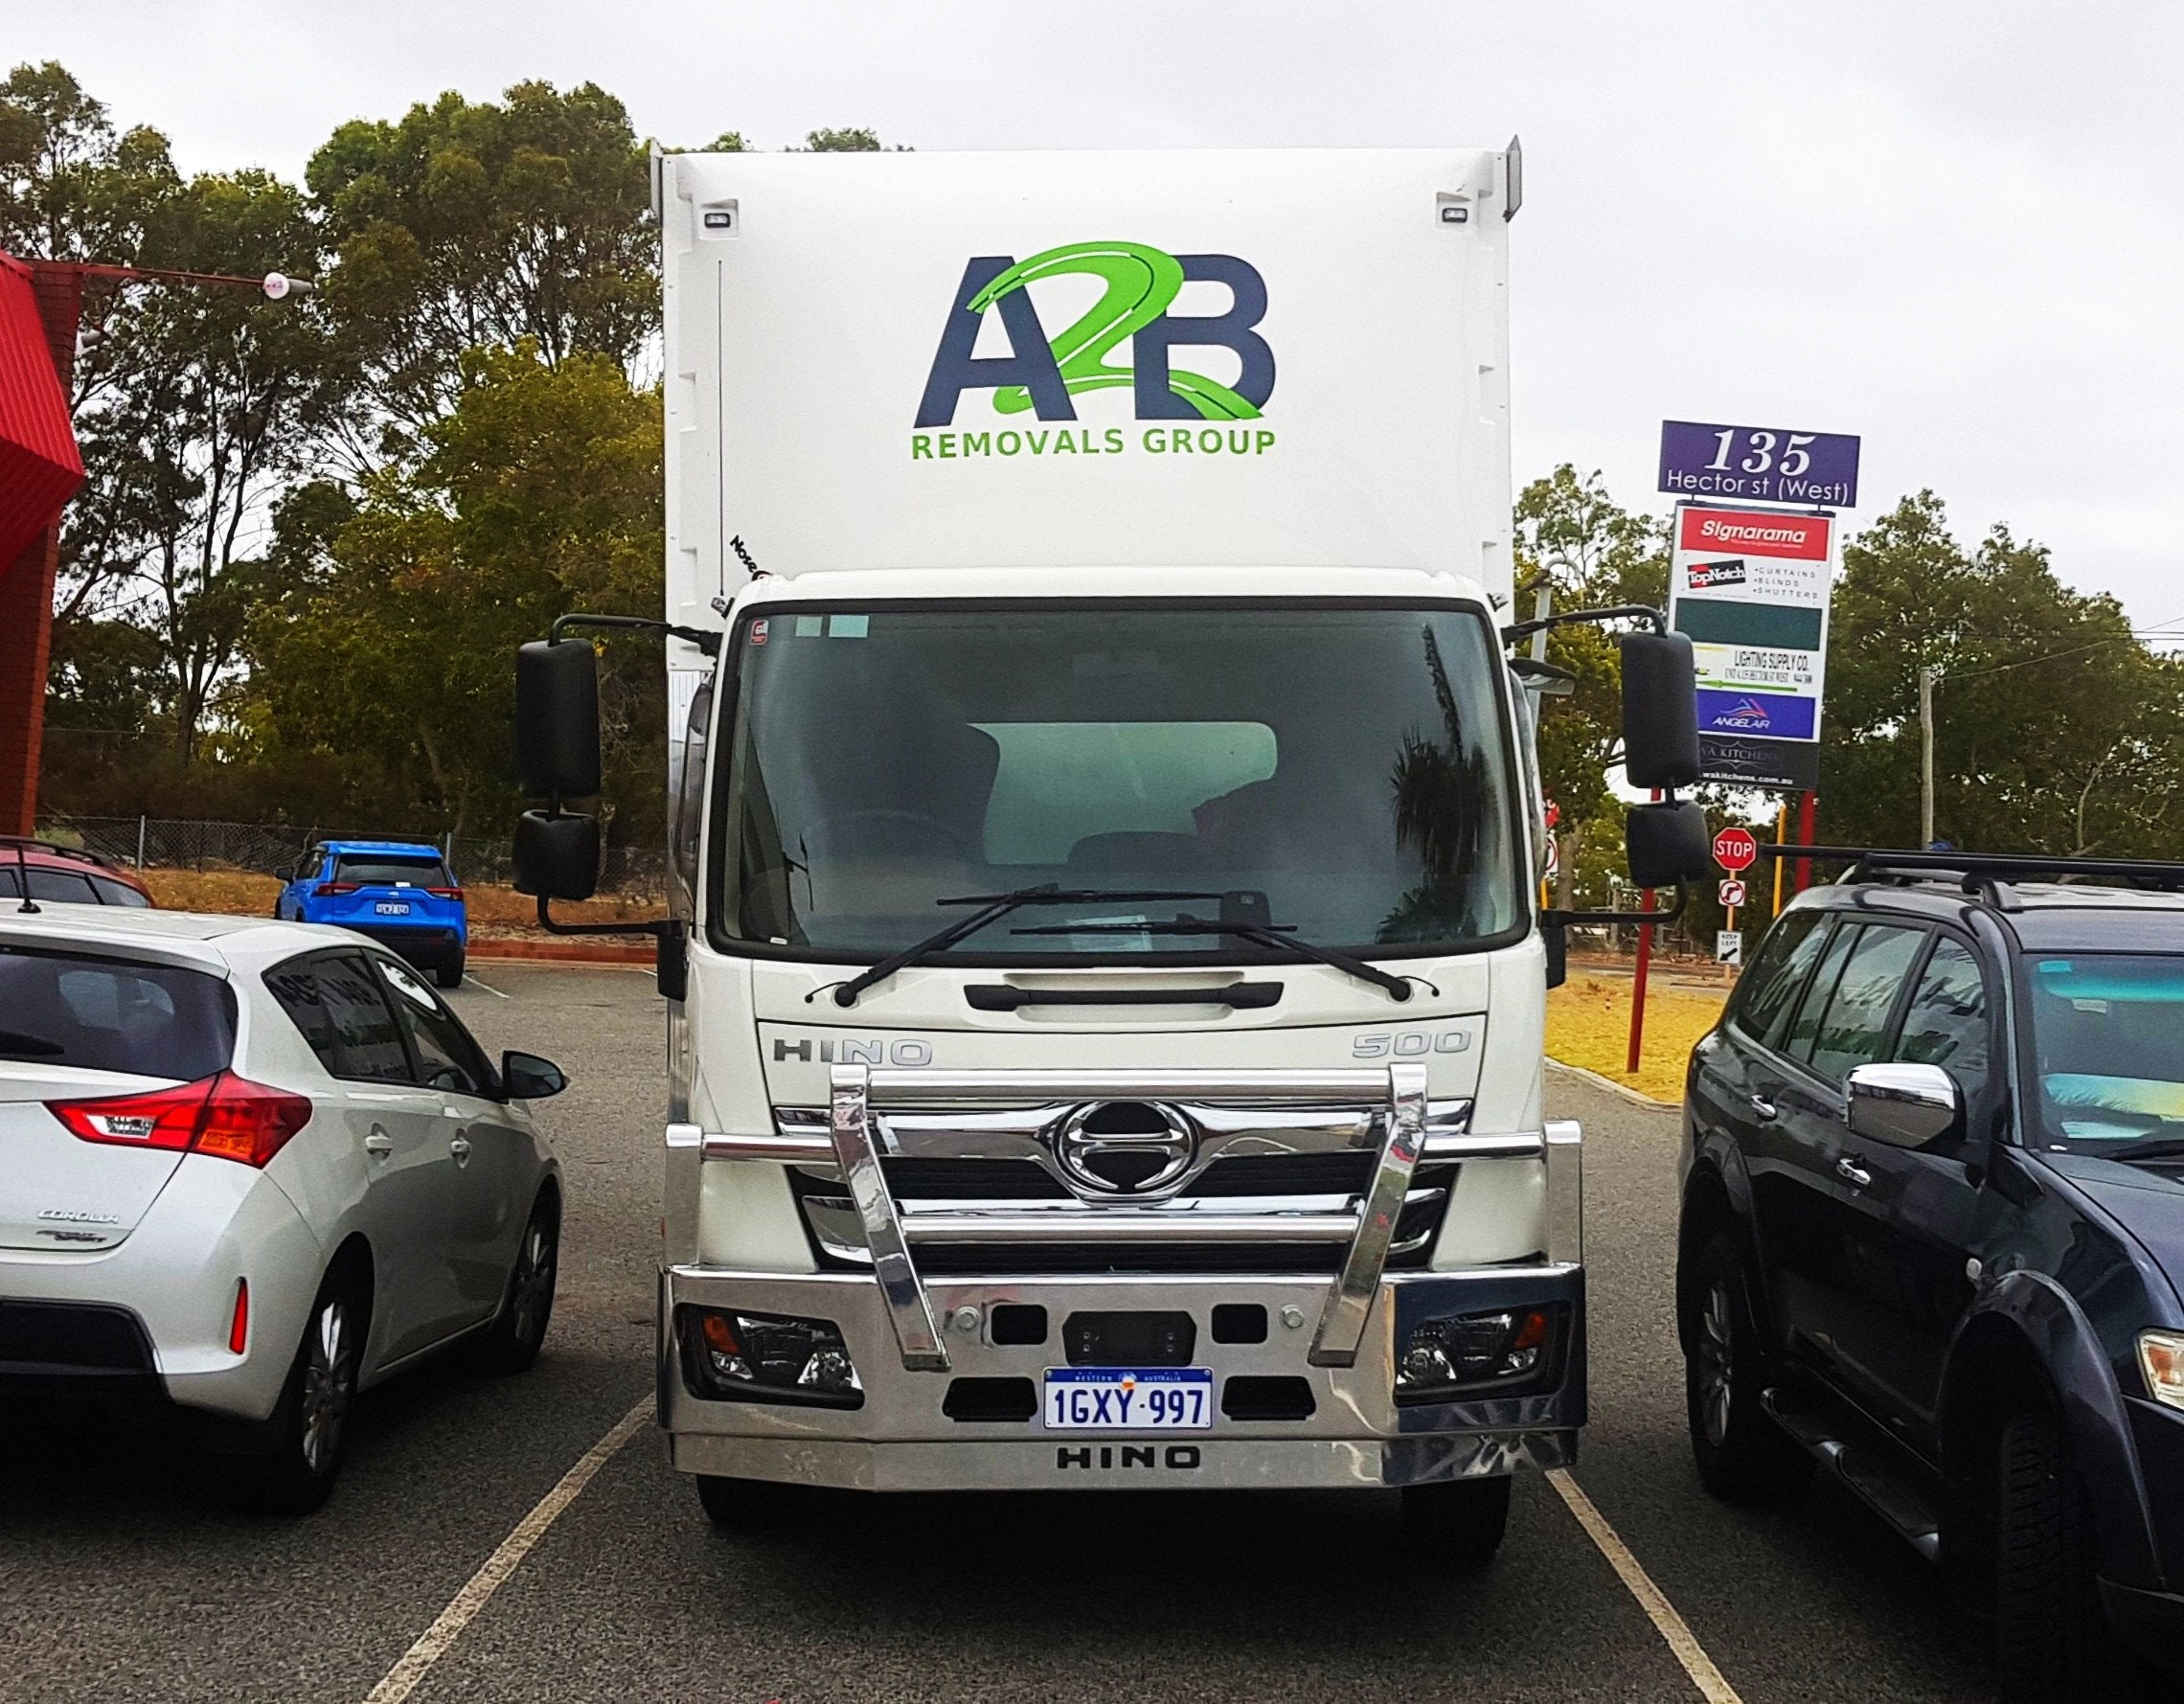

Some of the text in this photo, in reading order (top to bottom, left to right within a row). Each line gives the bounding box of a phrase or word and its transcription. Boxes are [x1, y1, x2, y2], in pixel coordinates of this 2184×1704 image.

[913, 240, 1277, 429] A2B
[911, 427, 1277, 460] REMOVALS GROUP
[1704, 429, 1816, 477] 135
[1667, 469, 1849, 505] Hector st (West)
[1700, 519, 1807, 544] Signarama
[1758, 577, 1800, 587] BLINDS
[1759, 567, 1816, 579] CURTAINS
[1757, 587, 1818, 600] SHUTTERS
[1735, 650, 1767, 669] LIGHTING
[1768, 652, 1796, 670] SUPPLY
[1712, 716, 1771, 729] ANGELAIR
[1716, 840, 1753, 858] STOP
[773, 1038, 933, 1067] HINO
[1352, 1029, 1472, 1059] 500
[37, 1210, 120, 1224] COROLLA
[1057, 1445, 1201, 1469] HINO
